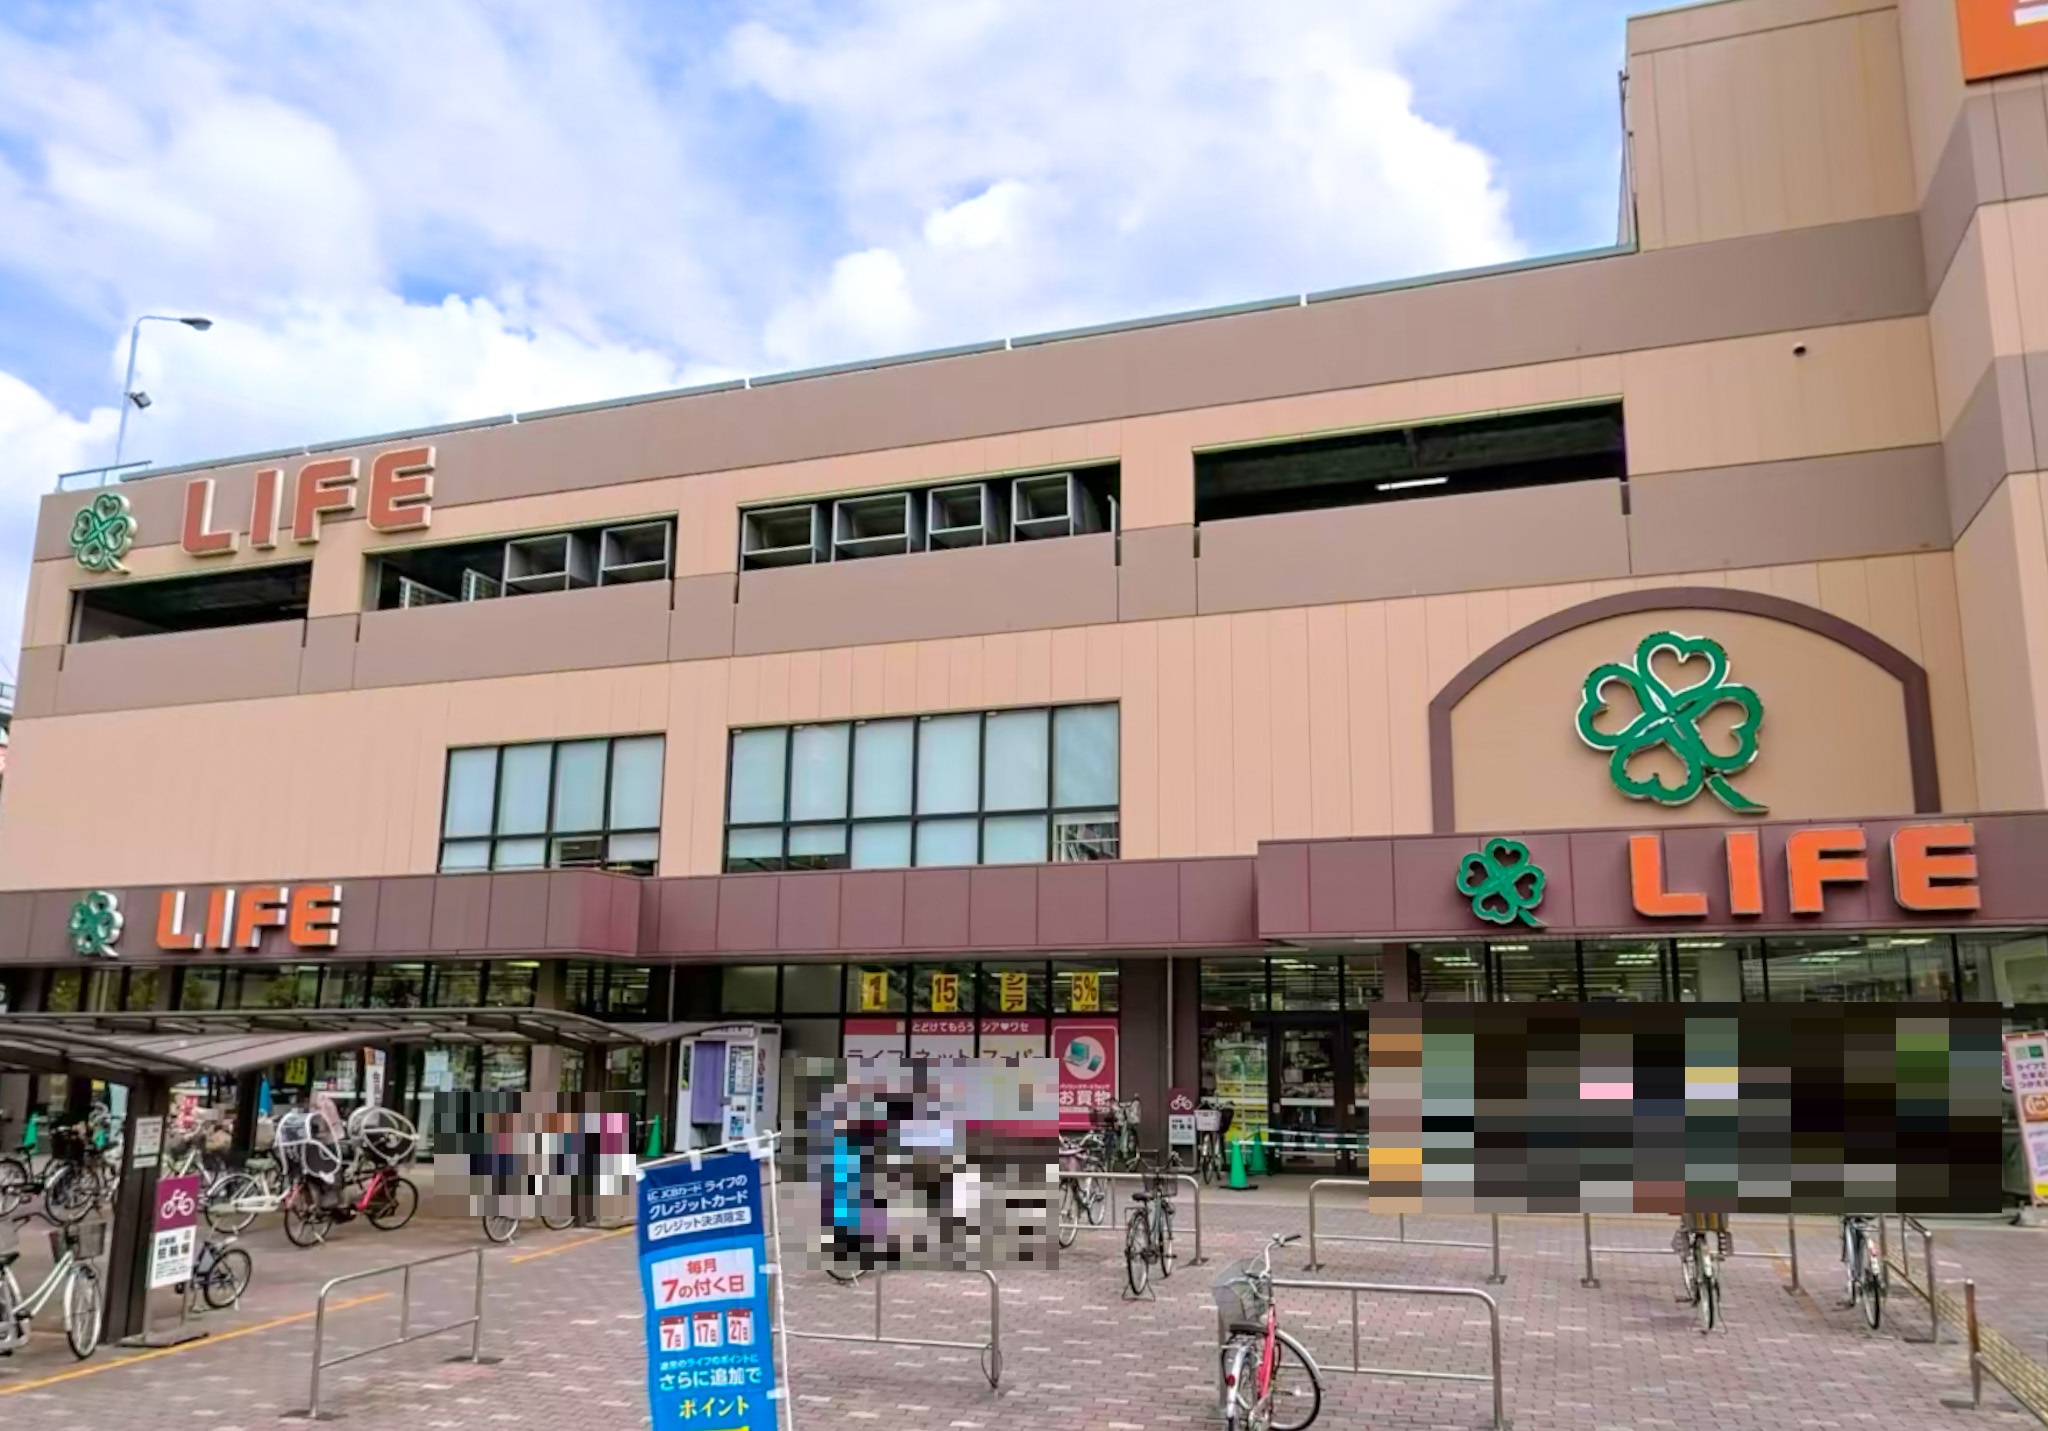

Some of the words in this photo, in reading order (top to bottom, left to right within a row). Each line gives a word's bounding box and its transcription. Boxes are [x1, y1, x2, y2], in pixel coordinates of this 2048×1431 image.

[180, 445, 436, 557] LIFE
[1628, 822, 1982, 917] LIFE
[156, 885, 343, 950] LIFE
[934, 977, 956, 1003] 15
[1005, 973, 1023, 1011] シニア
[1073, 975, 1097, 1001] 5%
[912, 1021, 975, 1033] とどけてもらう
[705, 1174, 748, 1193] ライフの
[648, 1189, 748, 1220] クレジットカード
[653, 1210, 746, 1236] クレジット決済限定
[686, 1257, 717, 1274] 毎月
[661, 1275, 745, 1302] 7の付く日
[659, 1367, 762, 1391] さらに追加で
[678, 1394, 750, 1420] ポイント
